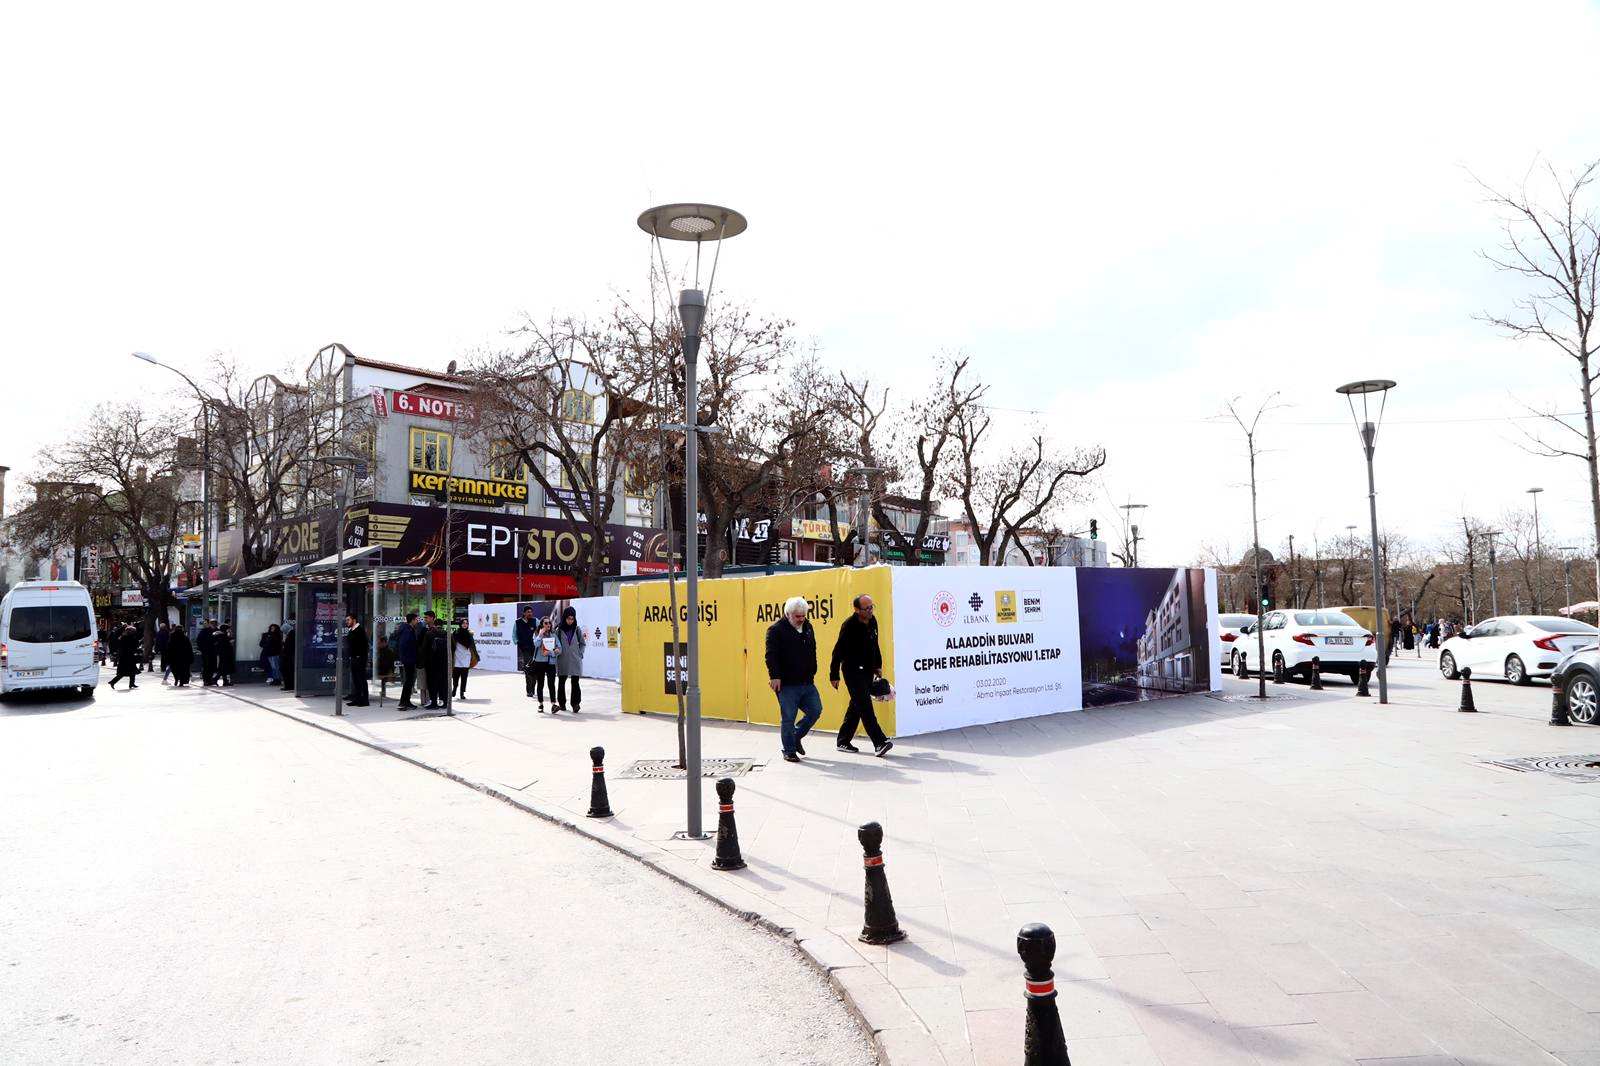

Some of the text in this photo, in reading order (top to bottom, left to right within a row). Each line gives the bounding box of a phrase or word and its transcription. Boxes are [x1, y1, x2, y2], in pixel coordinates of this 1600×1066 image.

[398, 394, 413, 410] 6.
[275, 521, 319, 554] TORE
[922, 536, 940, 550] Cafe
[526, 528, 610, 564] STO
[680, 600, 718, 626] GİŞİ
[756, 601, 786, 622] ARA
[1024, 606, 1040, 614] ŞEHRİM
[946, 632, 1034, 650] ALAADDİN BULVARI
[666, 656, 687, 668] BNİ
[914, 648, 1061, 671] CEPHE REHABİLİTASYONU 1.ETAP
[666, 670, 688, 682] ŞERİ
[976, 677, 1006, 688] 03.02.2020
[932, 684, 949, 692] Tarihi
[1012, 686, 1044, 695] Restorasyon
[915, 696, 944, 706] Yüklenici
